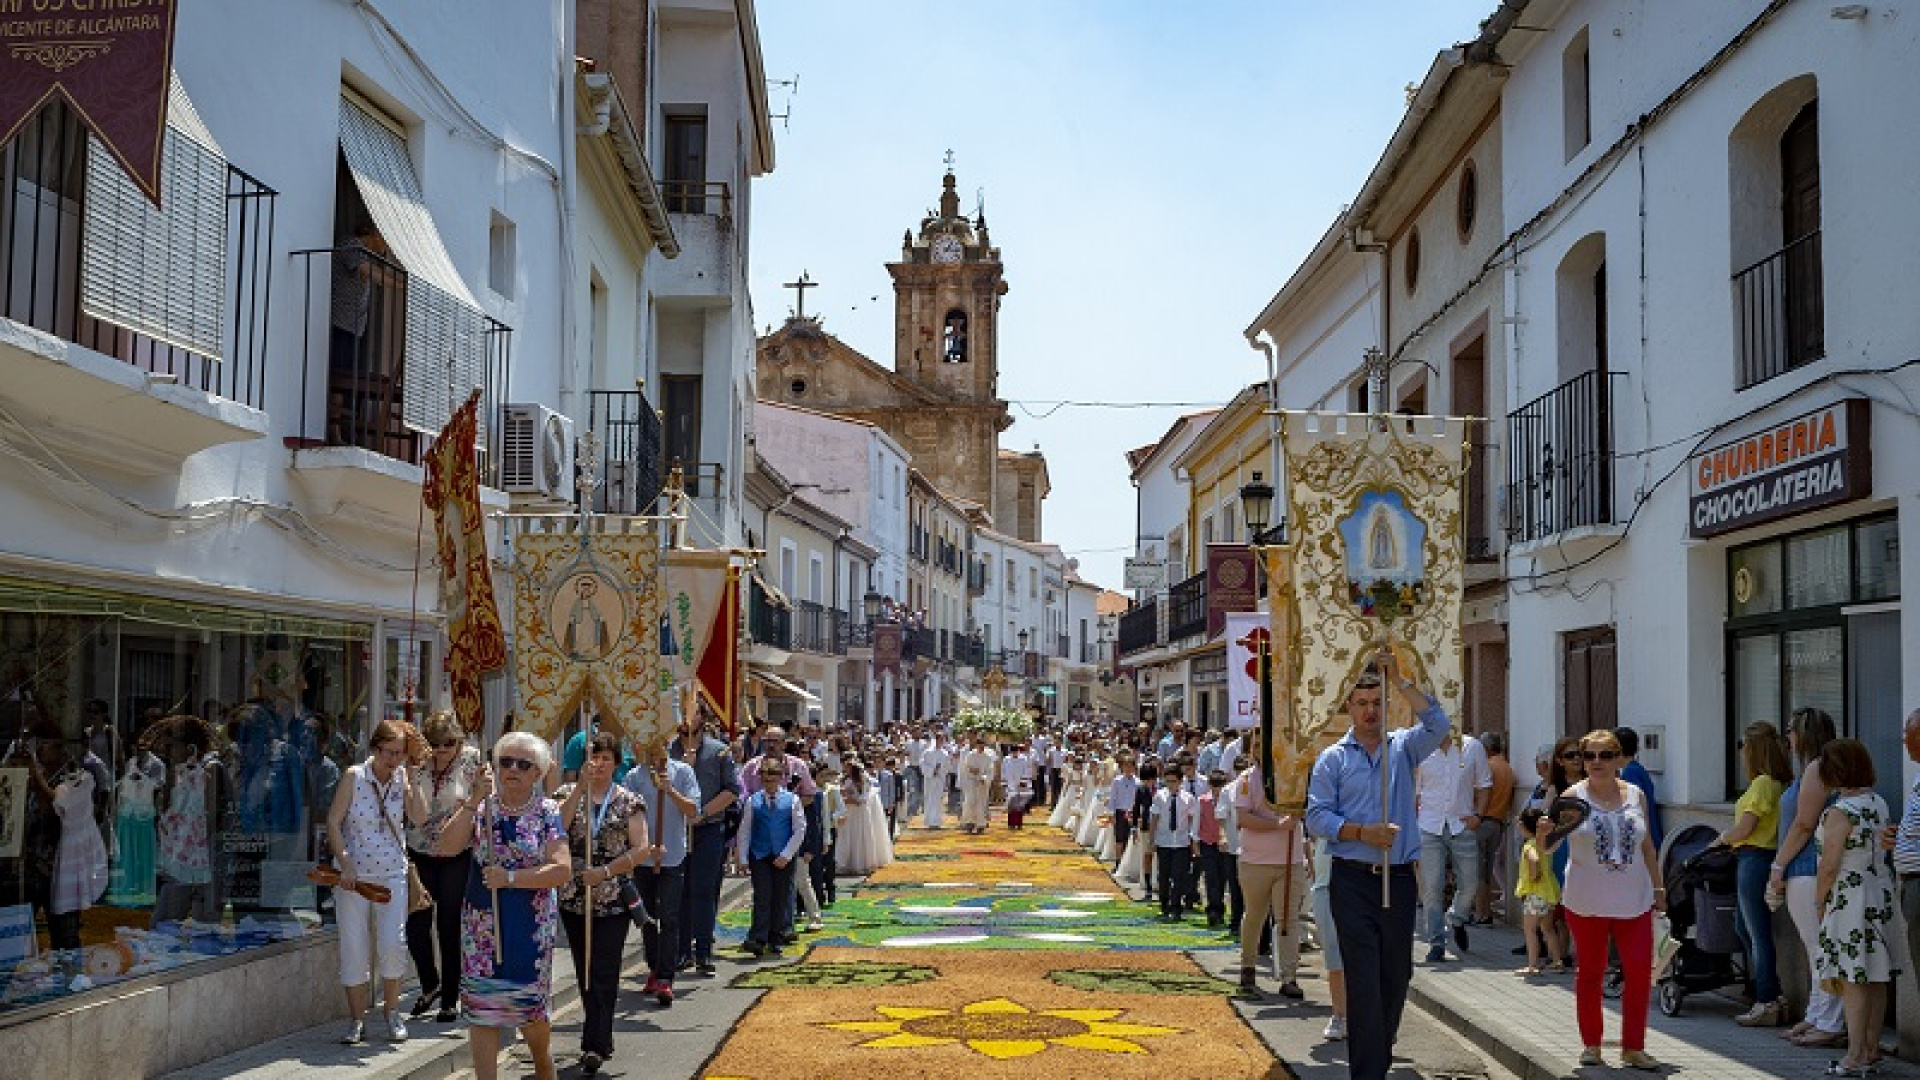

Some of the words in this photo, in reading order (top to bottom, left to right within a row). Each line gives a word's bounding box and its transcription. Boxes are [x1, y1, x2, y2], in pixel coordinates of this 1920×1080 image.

[55, 18, 75, 35] DE
[1699, 411, 1836, 490] CHURRERIA
[1694, 458, 1843, 528] CHOCOLATERIA
